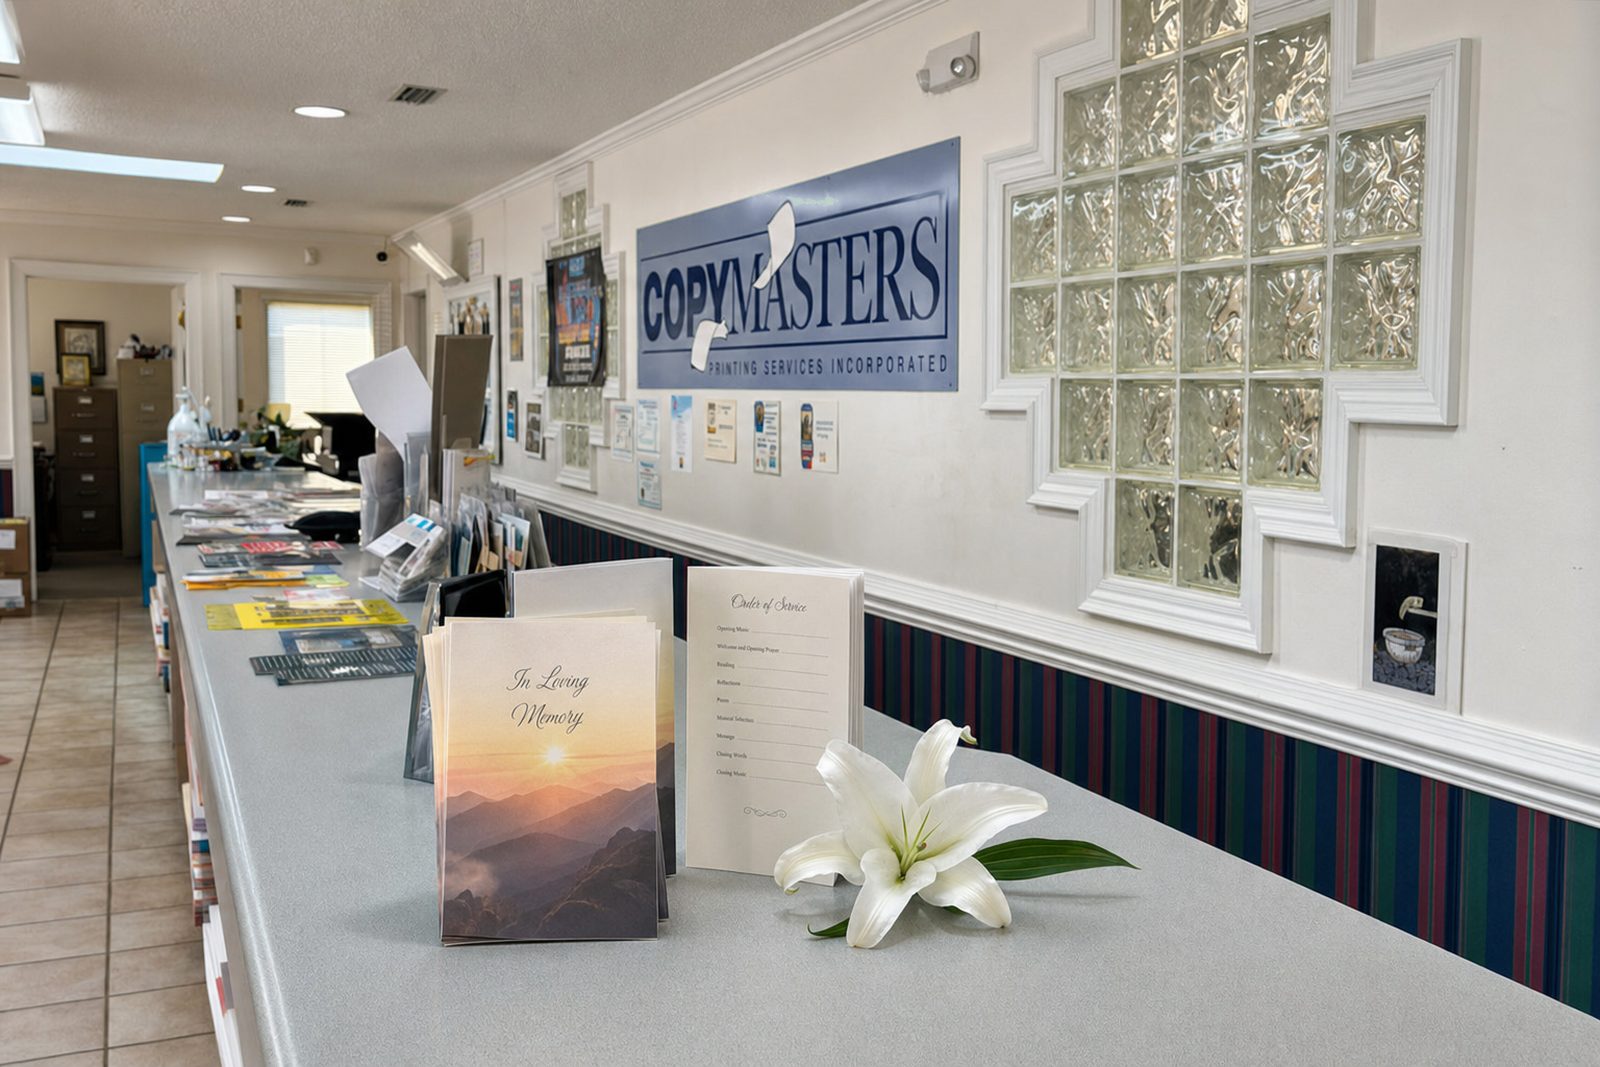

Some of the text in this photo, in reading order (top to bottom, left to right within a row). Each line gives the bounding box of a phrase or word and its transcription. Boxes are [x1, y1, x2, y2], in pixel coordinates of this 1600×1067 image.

[643, 216, 941, 342] COPYMASTERS
[708, 354, 947, 376] PRINTING SERVICES INCORPORATED
[731, 593, 808, 615] Order of Service
[506, 664, 590, 698] In Loving
[511, 702, 585, 735] Memory
